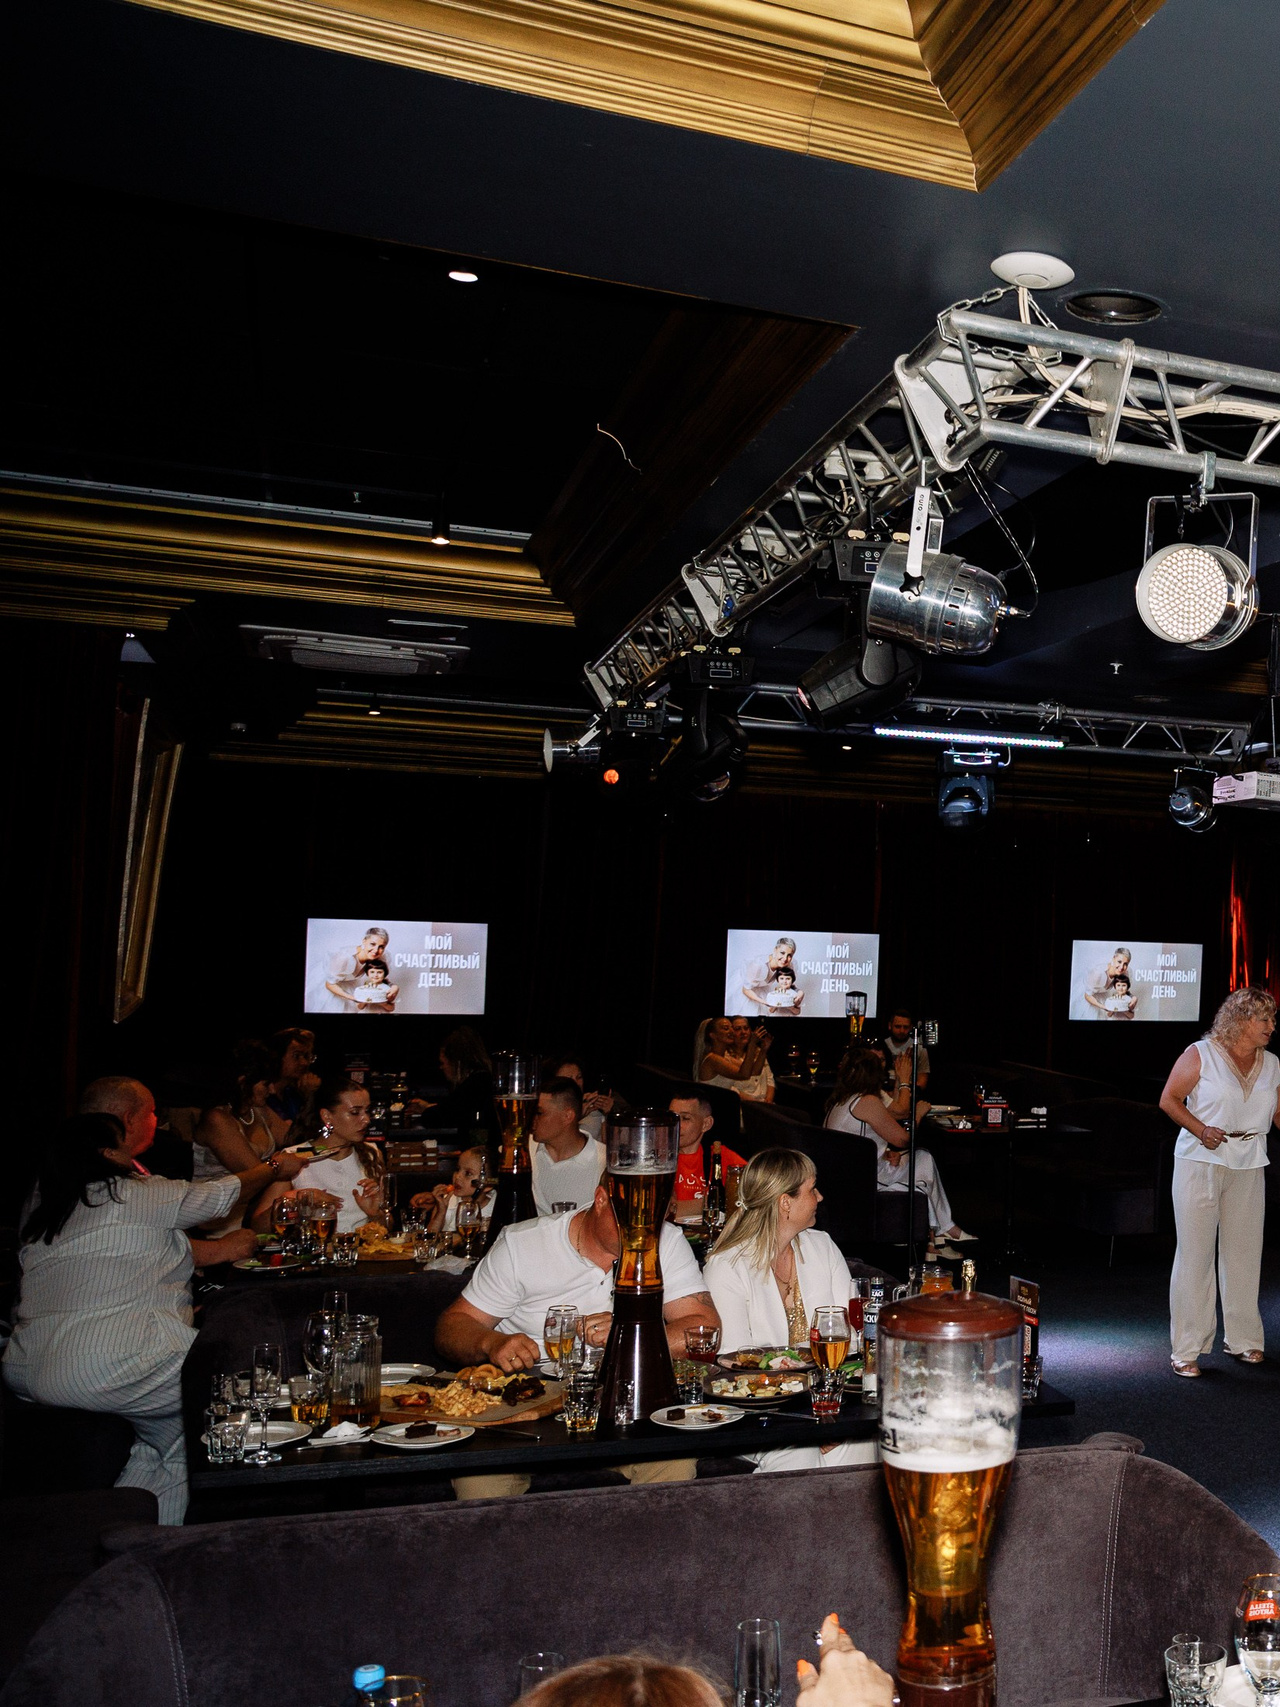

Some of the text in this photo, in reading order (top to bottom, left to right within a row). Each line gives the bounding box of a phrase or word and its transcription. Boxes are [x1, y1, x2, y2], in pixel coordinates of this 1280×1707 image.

[424, 933, 452, 950] МОЙ
[826, 942, 849, 959] МОЙ
[394, 951, 480, 969] СЧАСТЛИВЫЙ
[1156, 951, 1177, 967] МОЙ
[800, 960, 873, 976] СЧАСТЛИВЫЙ
[1135, 968, 1197, 983] СЧАСТЛИВЫЙ
[417, 971, 453, 988] ДЕНЬ
[820, 978, 850, 993] ДЕНЬ
[1151, 984, 1177, 999] ДЕНЬ
